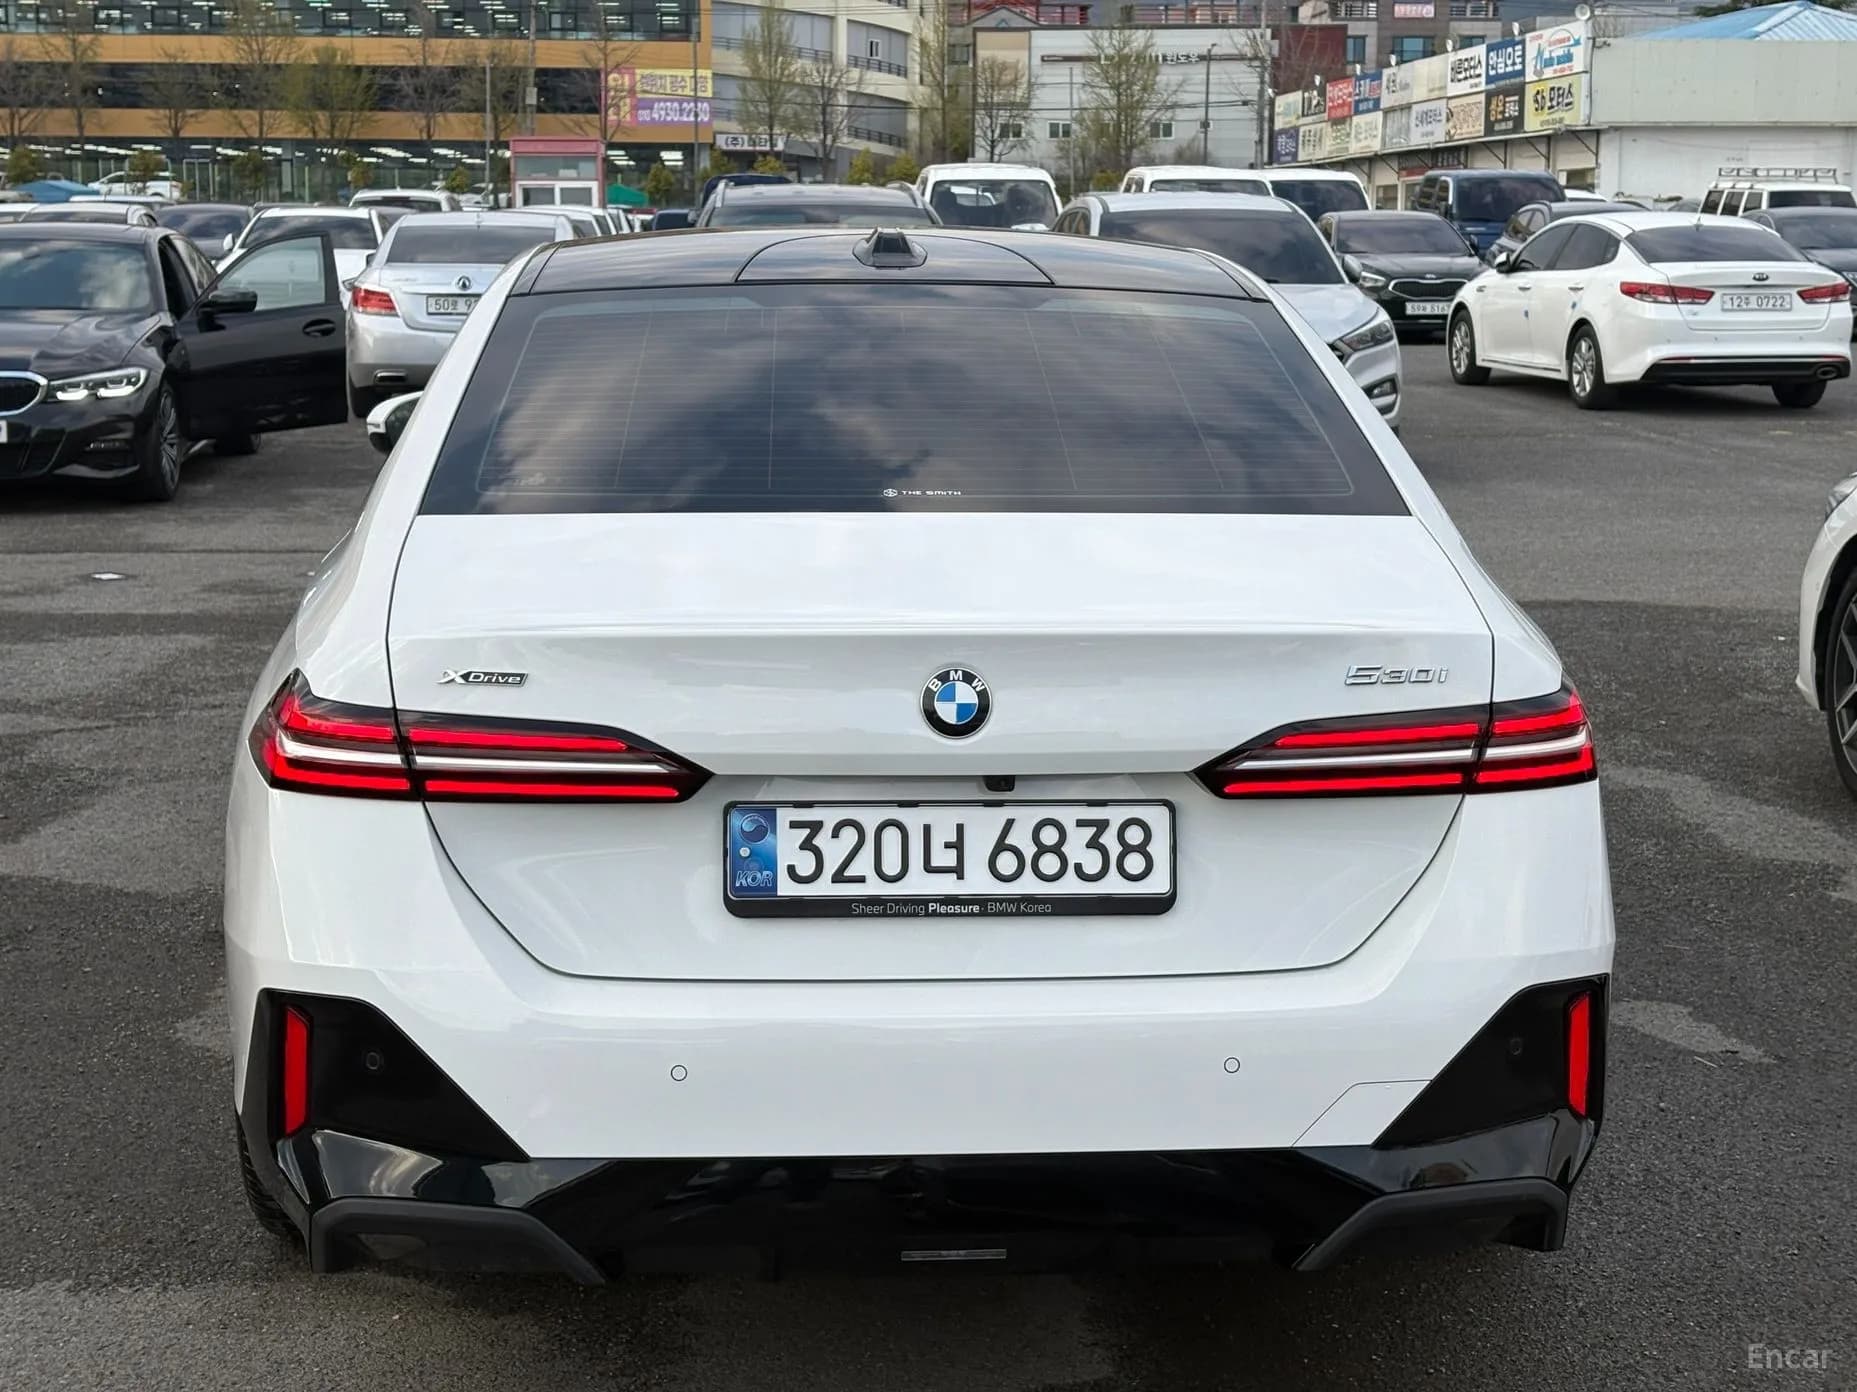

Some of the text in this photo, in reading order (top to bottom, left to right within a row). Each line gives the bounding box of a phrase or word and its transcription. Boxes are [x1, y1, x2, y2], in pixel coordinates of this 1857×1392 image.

[1548, 82, 1573, 111] 모터스
[927, 670, 986, 692] BMW
[1344, 664, 1448, 685] 530i
[786, 816, 1154, 884] 320너 6838
[735, 870, 773, 887] KOR
[851, 901, 1052, 916] Sheer Driving Pleasure BMW Korea
